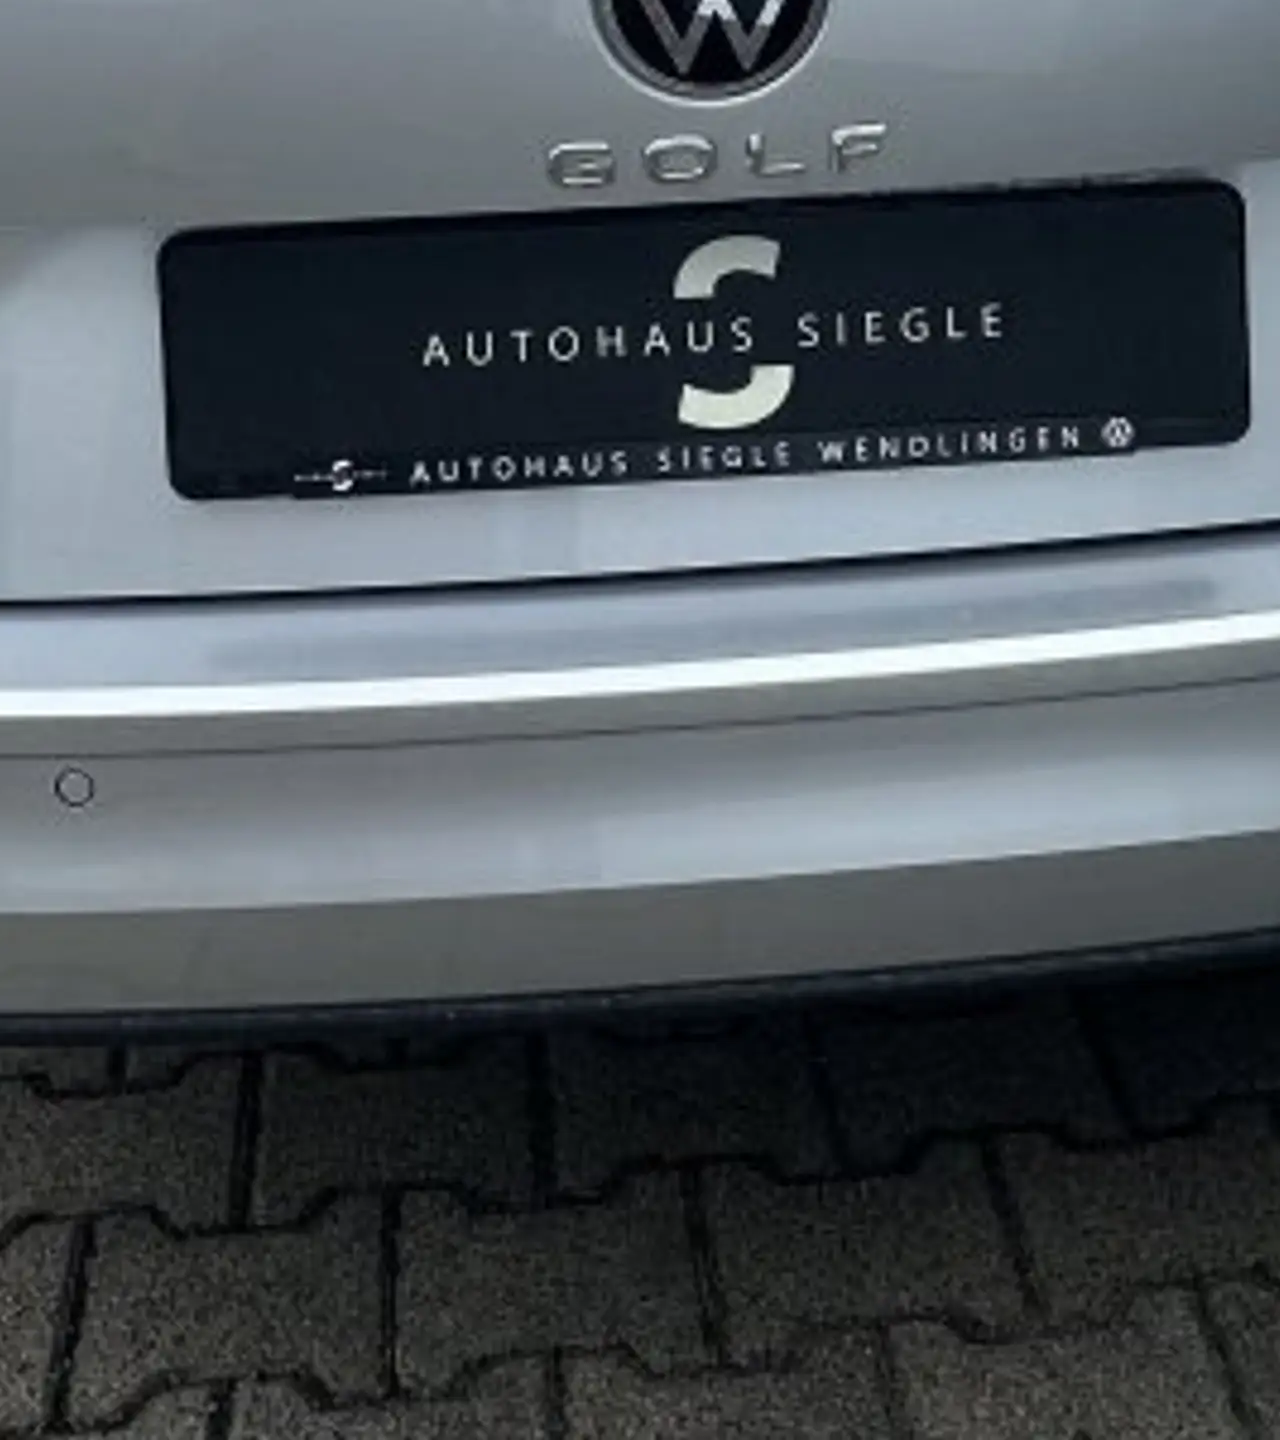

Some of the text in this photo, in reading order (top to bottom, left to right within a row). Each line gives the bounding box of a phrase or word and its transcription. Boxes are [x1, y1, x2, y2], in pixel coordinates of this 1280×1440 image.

[546, 121, 888, 188] GOLF
[421, 301, 1005, 368] AUTOHAUS SIEGLE
[409, 450, 628, 486] AUTOHAUS
[655, 440, 791, 475] SIEGLE
[816, 425, 1081, 464] WENDLINGEN
